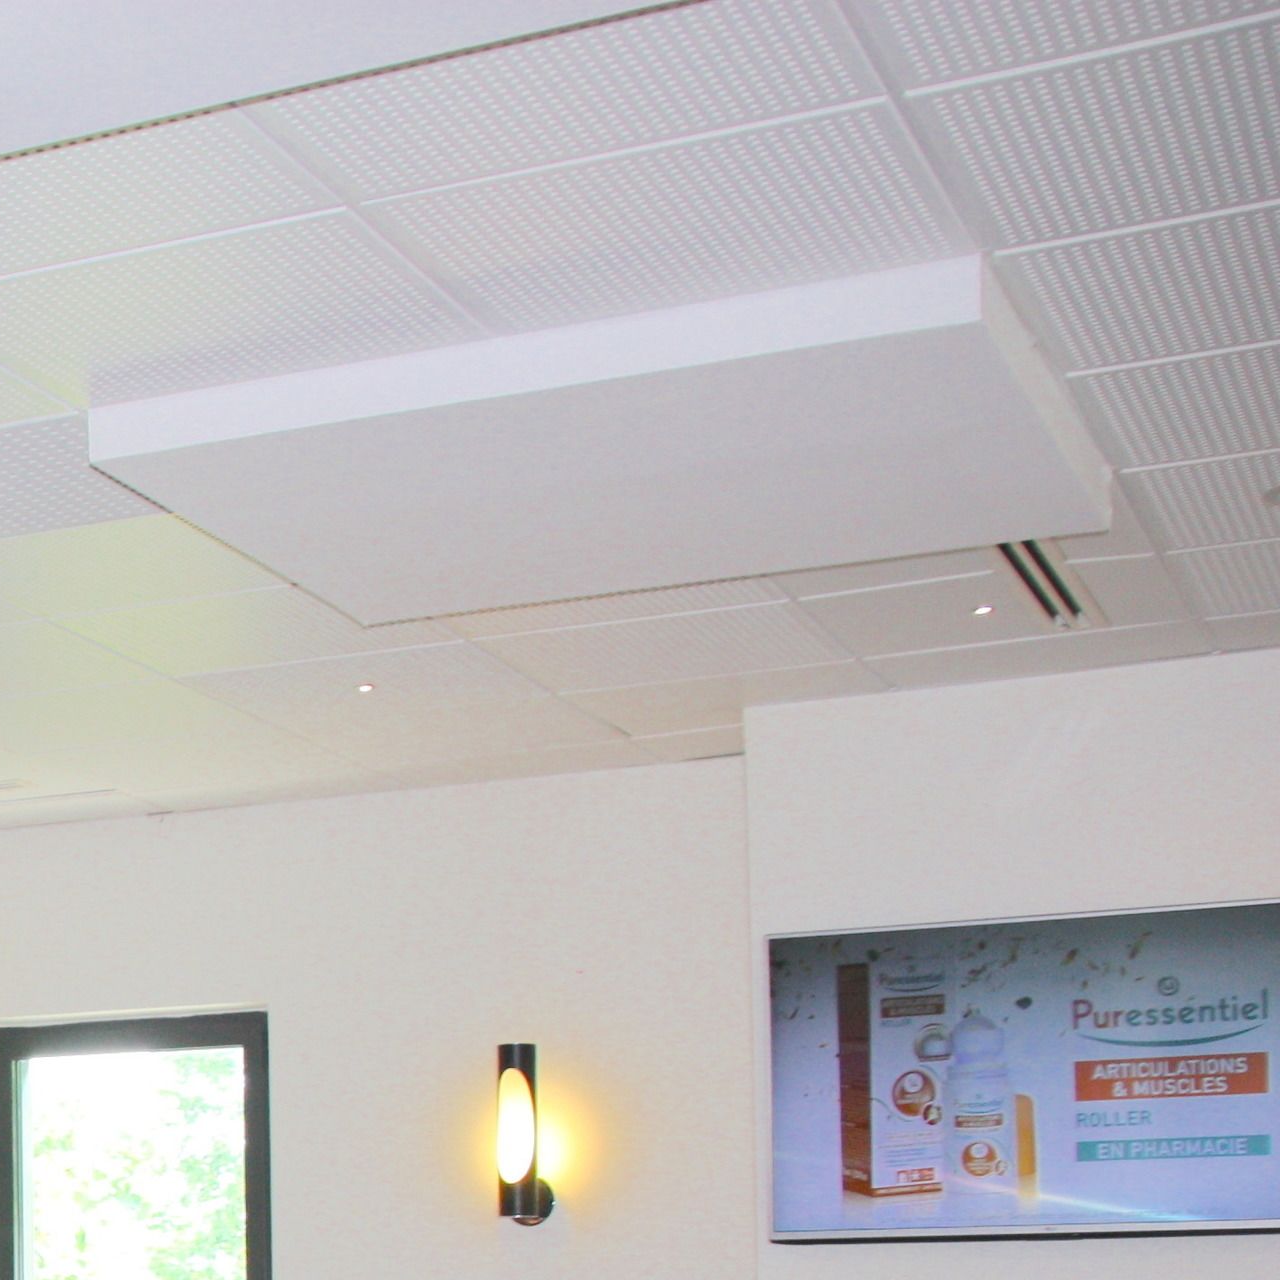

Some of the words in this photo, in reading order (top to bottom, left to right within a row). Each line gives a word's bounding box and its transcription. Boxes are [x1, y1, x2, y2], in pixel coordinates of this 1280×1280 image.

[1092, 1057, 1249, 1080] ARTICULATIONS
[1113, 1081, 1128, 1098] &
[1133, 1077, 1229, 1096] MUSCLES
[1076, 1110, 1153, 1128] ROLLER
[1096, 1142, 1125, 1160] EN
[1130, 1138, 1249, 1159] PHARMACIE
